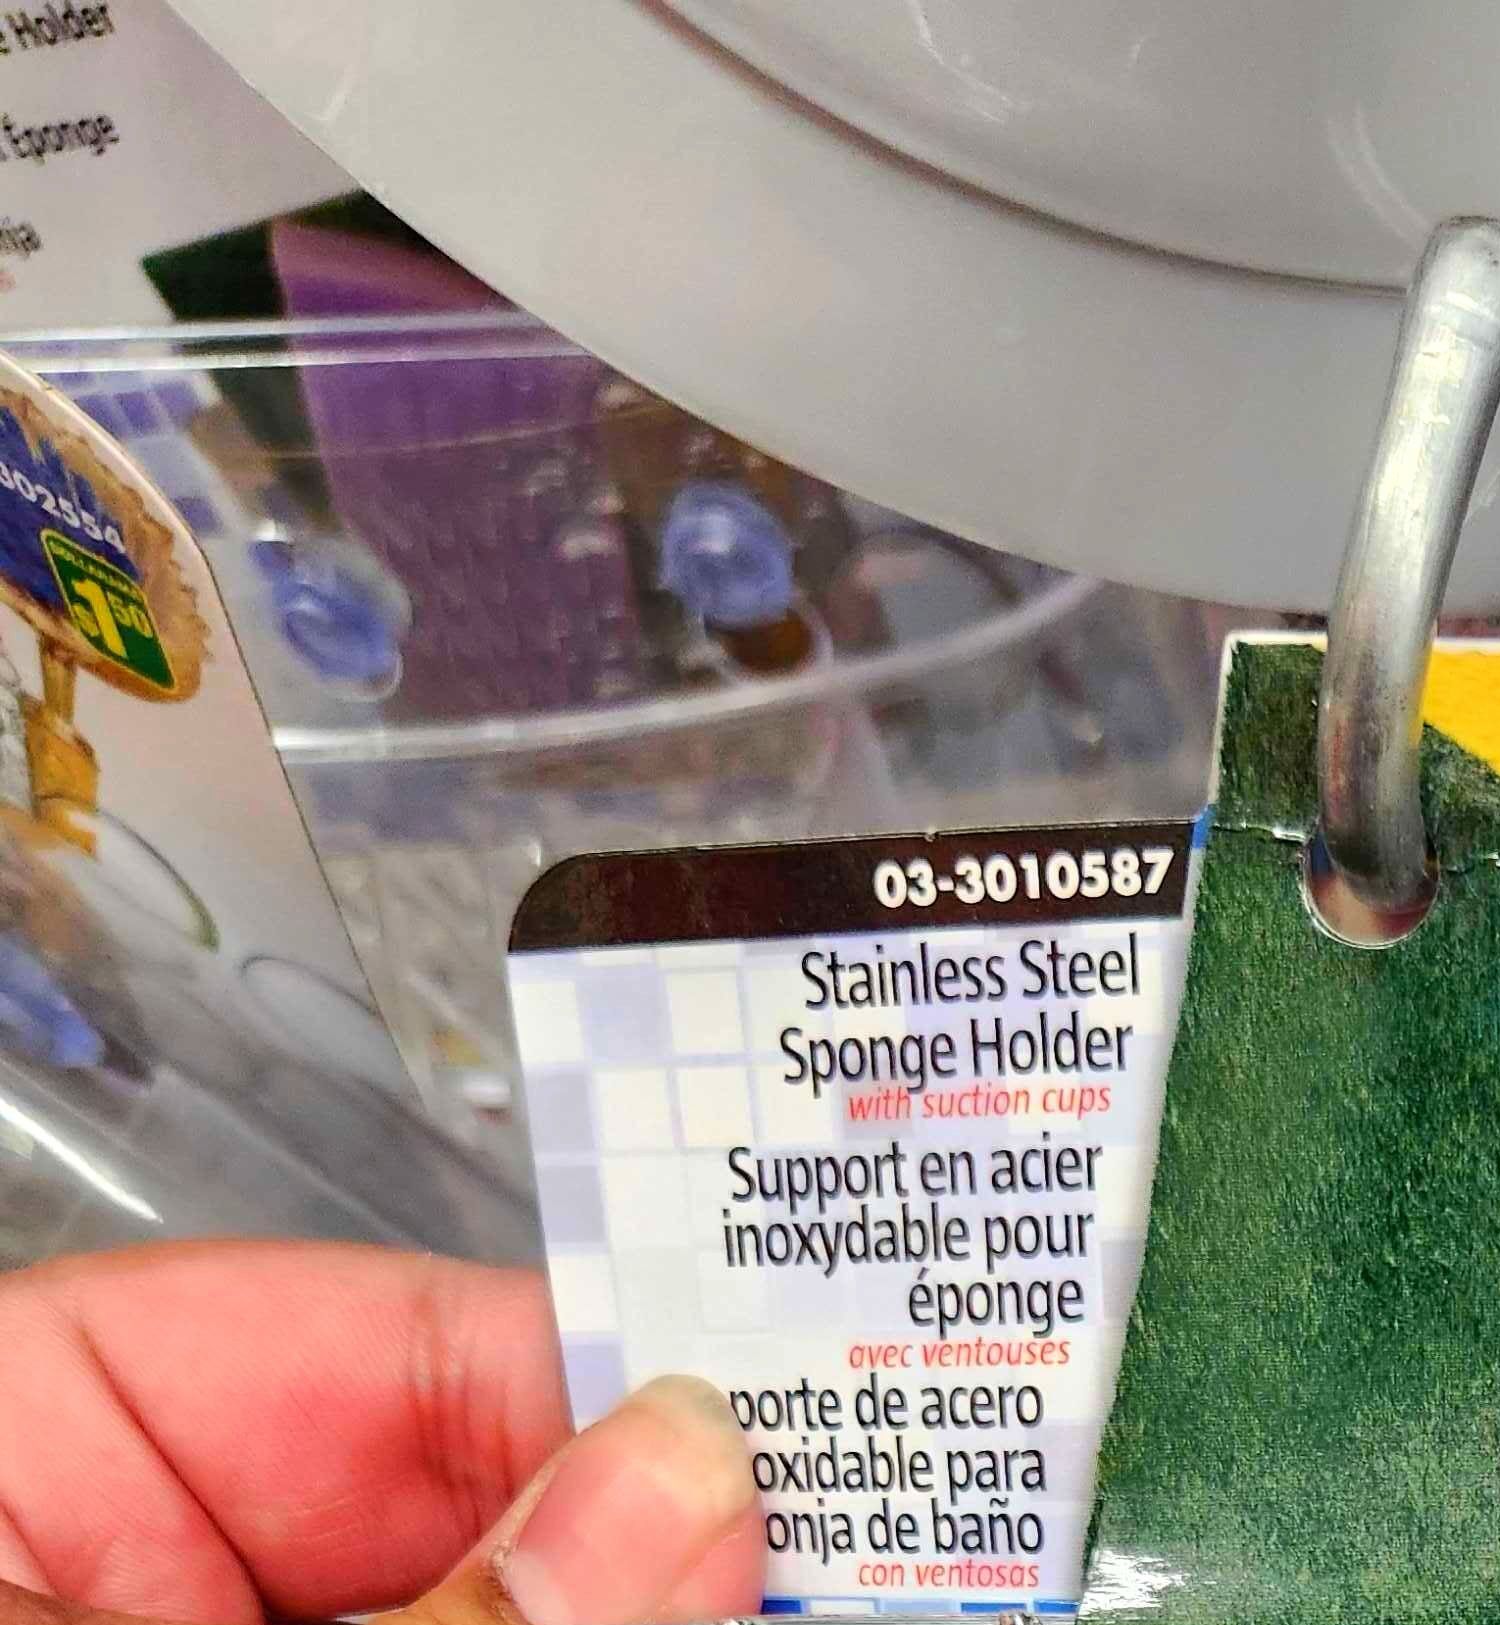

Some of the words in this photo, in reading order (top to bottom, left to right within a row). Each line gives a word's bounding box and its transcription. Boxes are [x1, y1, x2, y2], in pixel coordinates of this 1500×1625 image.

[873, 847, 1177, 911] 03-3010587
[800, 941, 1008, 1011] Stainless
[1020, 931, 1142, 998] Steel
[778, 1025, 958, 1099] Sponge
[971, 1010, 1135, 1078] Holder
[848, 1087, 912, 1122] with
[922, 1083, 1031, 1120] suction
[1041, 1083, 1113, 1120] cups
[726, 1140, 909, 1212] Support
[921, 1150, 984, 1195] en
[991, 1131, 1105, 1193] acier
[722, 1207, 971, 1277] inoxydable
[984, 1210, 1097, 1275] pour
[907, 1267, 1086, 1341] éponge
[848, 1342, 914, 1371] avec
[921, 1336, 1072, 1368] ventouses
[729, 1377, 844, 1432] porte
[855, 1371, 909, 1431] de
[922, 1382, 1045, 1430] acero
[752, 1436, 934, 1494] oxidable
[946, 1444, 1048, 1505] para
[765, 1498, 857, 1567] onja
[867, 1500, 922, 1557] de
[931, 1497, 1046, 1557] baño
[857, 1561, 906, 1589] con
[913, 1557, 1041, 1590] ventosas
